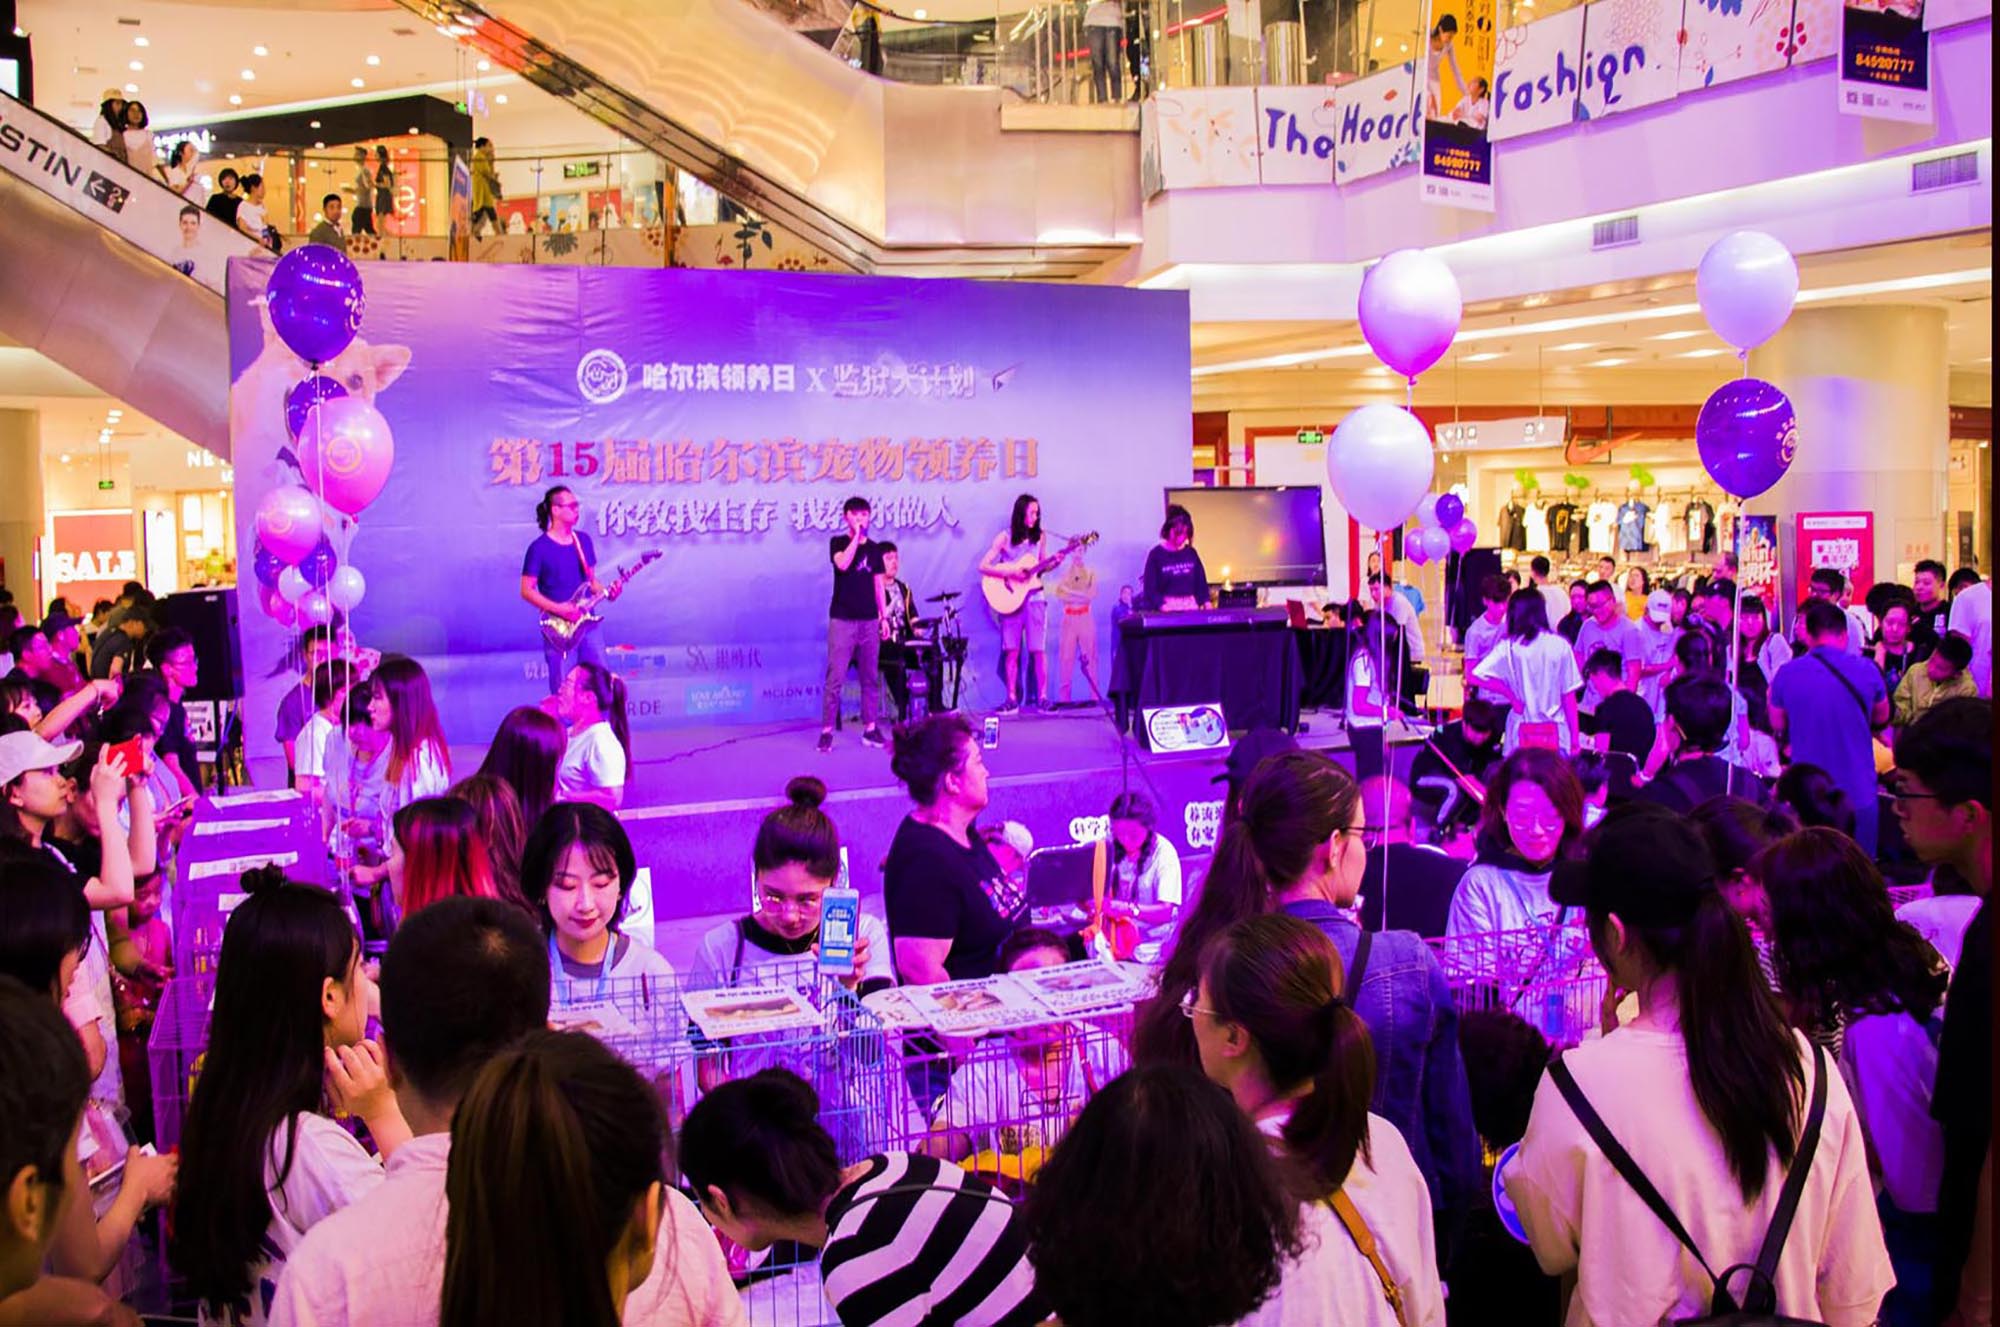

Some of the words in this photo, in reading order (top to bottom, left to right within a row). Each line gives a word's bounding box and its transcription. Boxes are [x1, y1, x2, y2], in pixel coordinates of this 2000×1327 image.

[1341, 93, 1422, 145] Heart
[0, 123, 82, 187] STIN
[489, 436, 1039, 485] 第15届哈尔滨宠物领养日
[596, 499, 779, 536] 你教我生存
[55, 550, 136, 583] SALE
